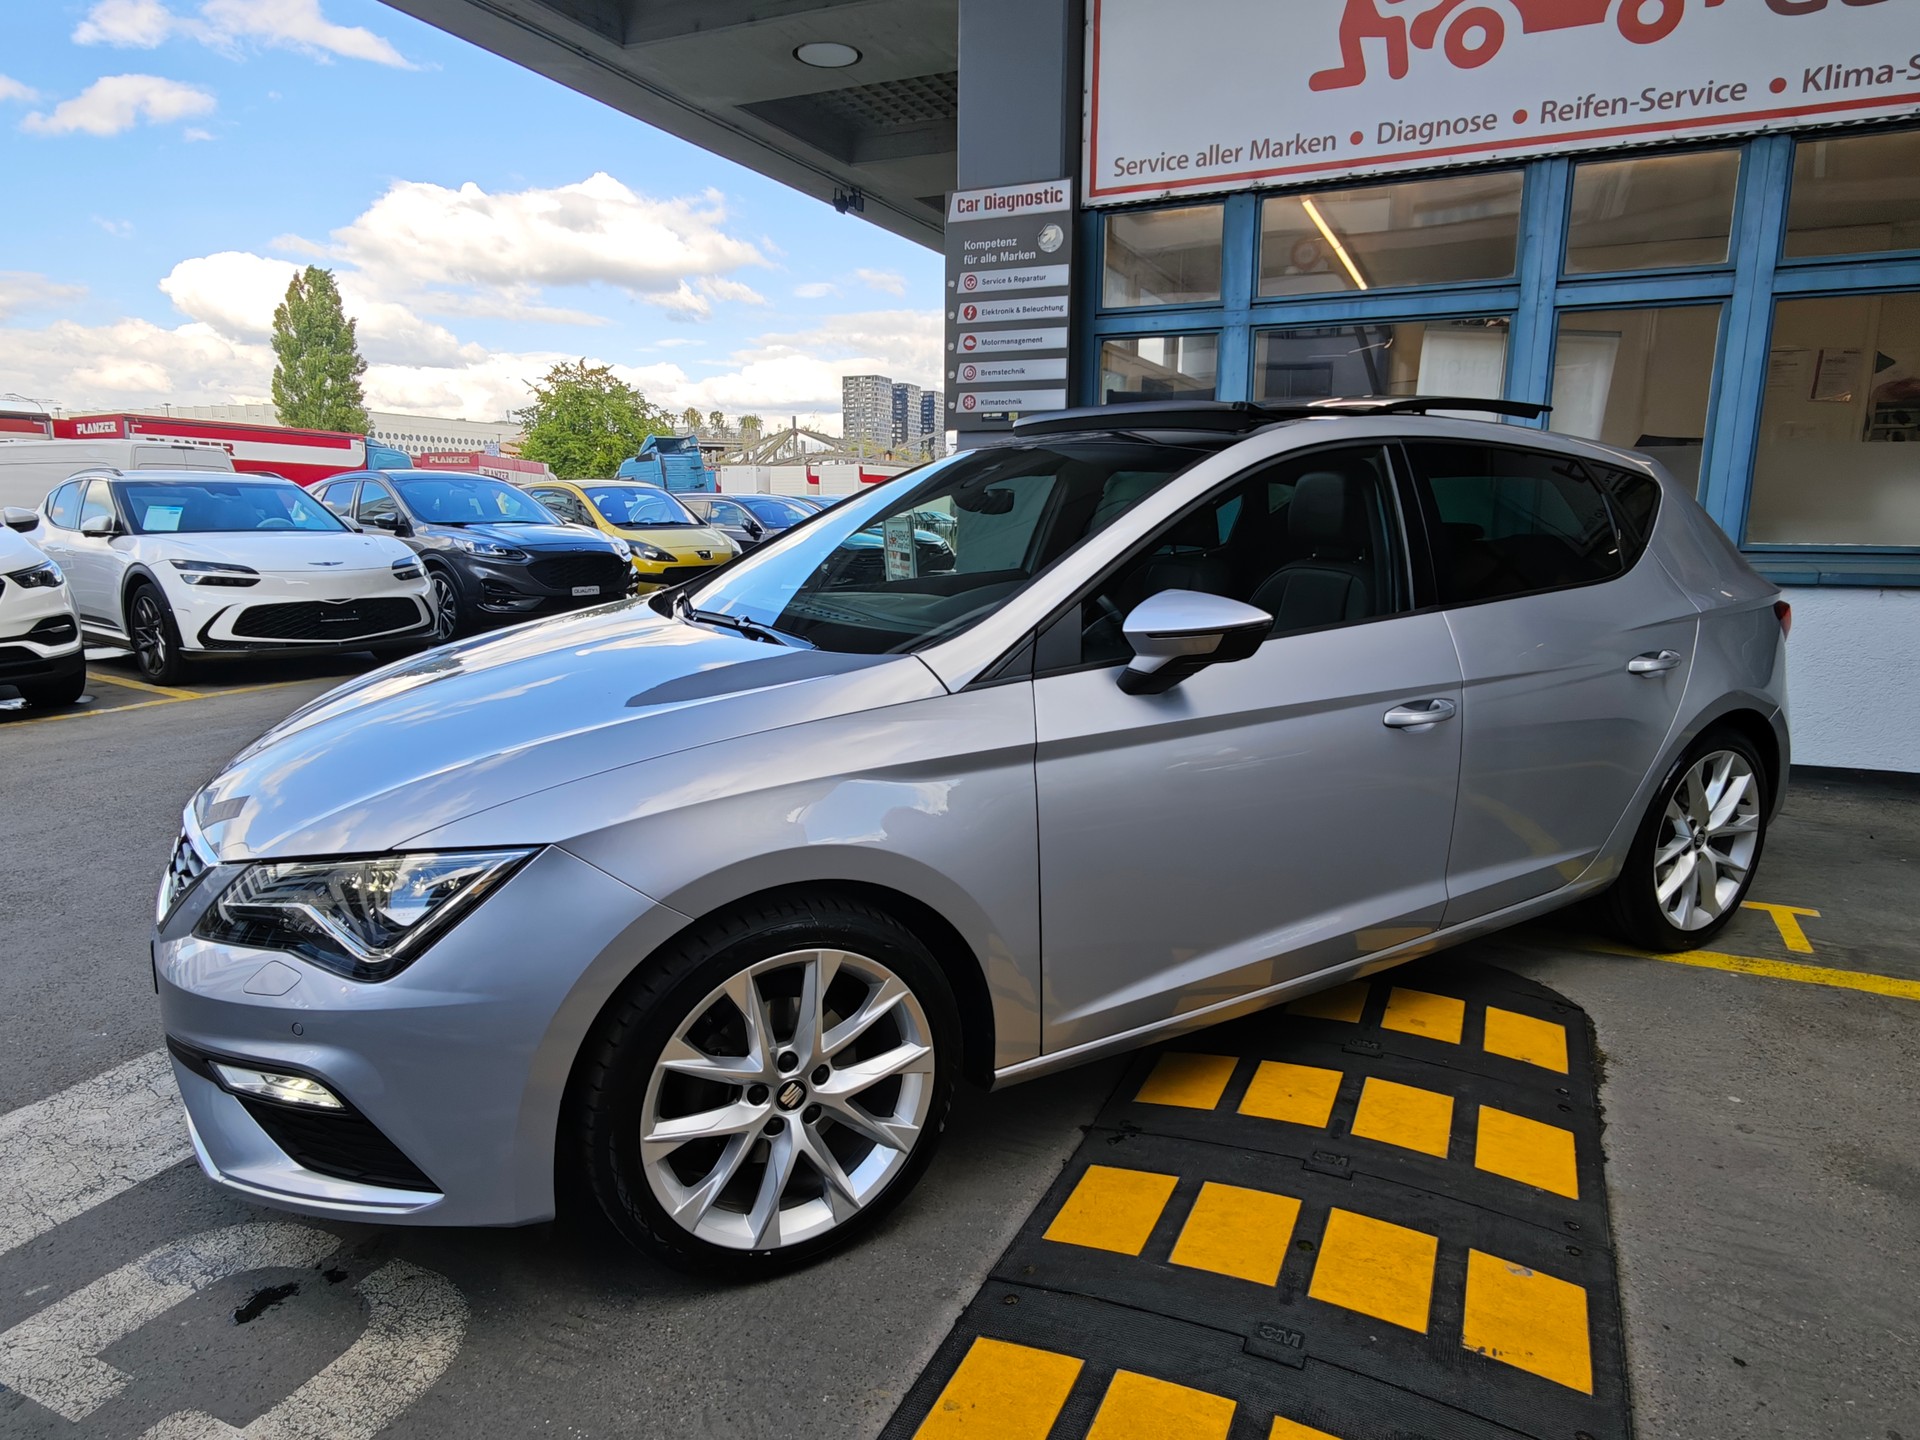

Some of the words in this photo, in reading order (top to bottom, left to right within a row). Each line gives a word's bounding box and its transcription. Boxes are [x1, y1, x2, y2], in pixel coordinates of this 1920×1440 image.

[1113, 151, 1189, 177] Service
[1195, 143, 1244, 168] aller
[1249, 132, 1337, 161] Marken
[1376, 112, 1498, 146] Diagnose
[1539, 79, 1748, 124] Reifen-Service
[957, 198, 981, 214] Car
[983, 186, 1063, 212] Diagnostic
[963, 237, 1018, 251] Kompetenz
[963, 254, 978, 265] für
[979, 252, 998, 264] alle
[1000, 250, 1037, 262] Marken
[981, 276, 1007, 286] Service
[1013, 274, 1047, 284] Reparatur
[981, 307, 1015, 316] Elektronik
[1015, 306, 1021, 314] &
[1022, 304, 1065, 314] Beleuchtung
[981, 336, 1043, 346] Motormanagement
[980, 367, 1026, 377] Bremstechnik
[980, 397, 1023, 407] Klimatechnik
[75, 421, 118, 435] PLANZER
[428, 455, 471, 464] PLANZER
